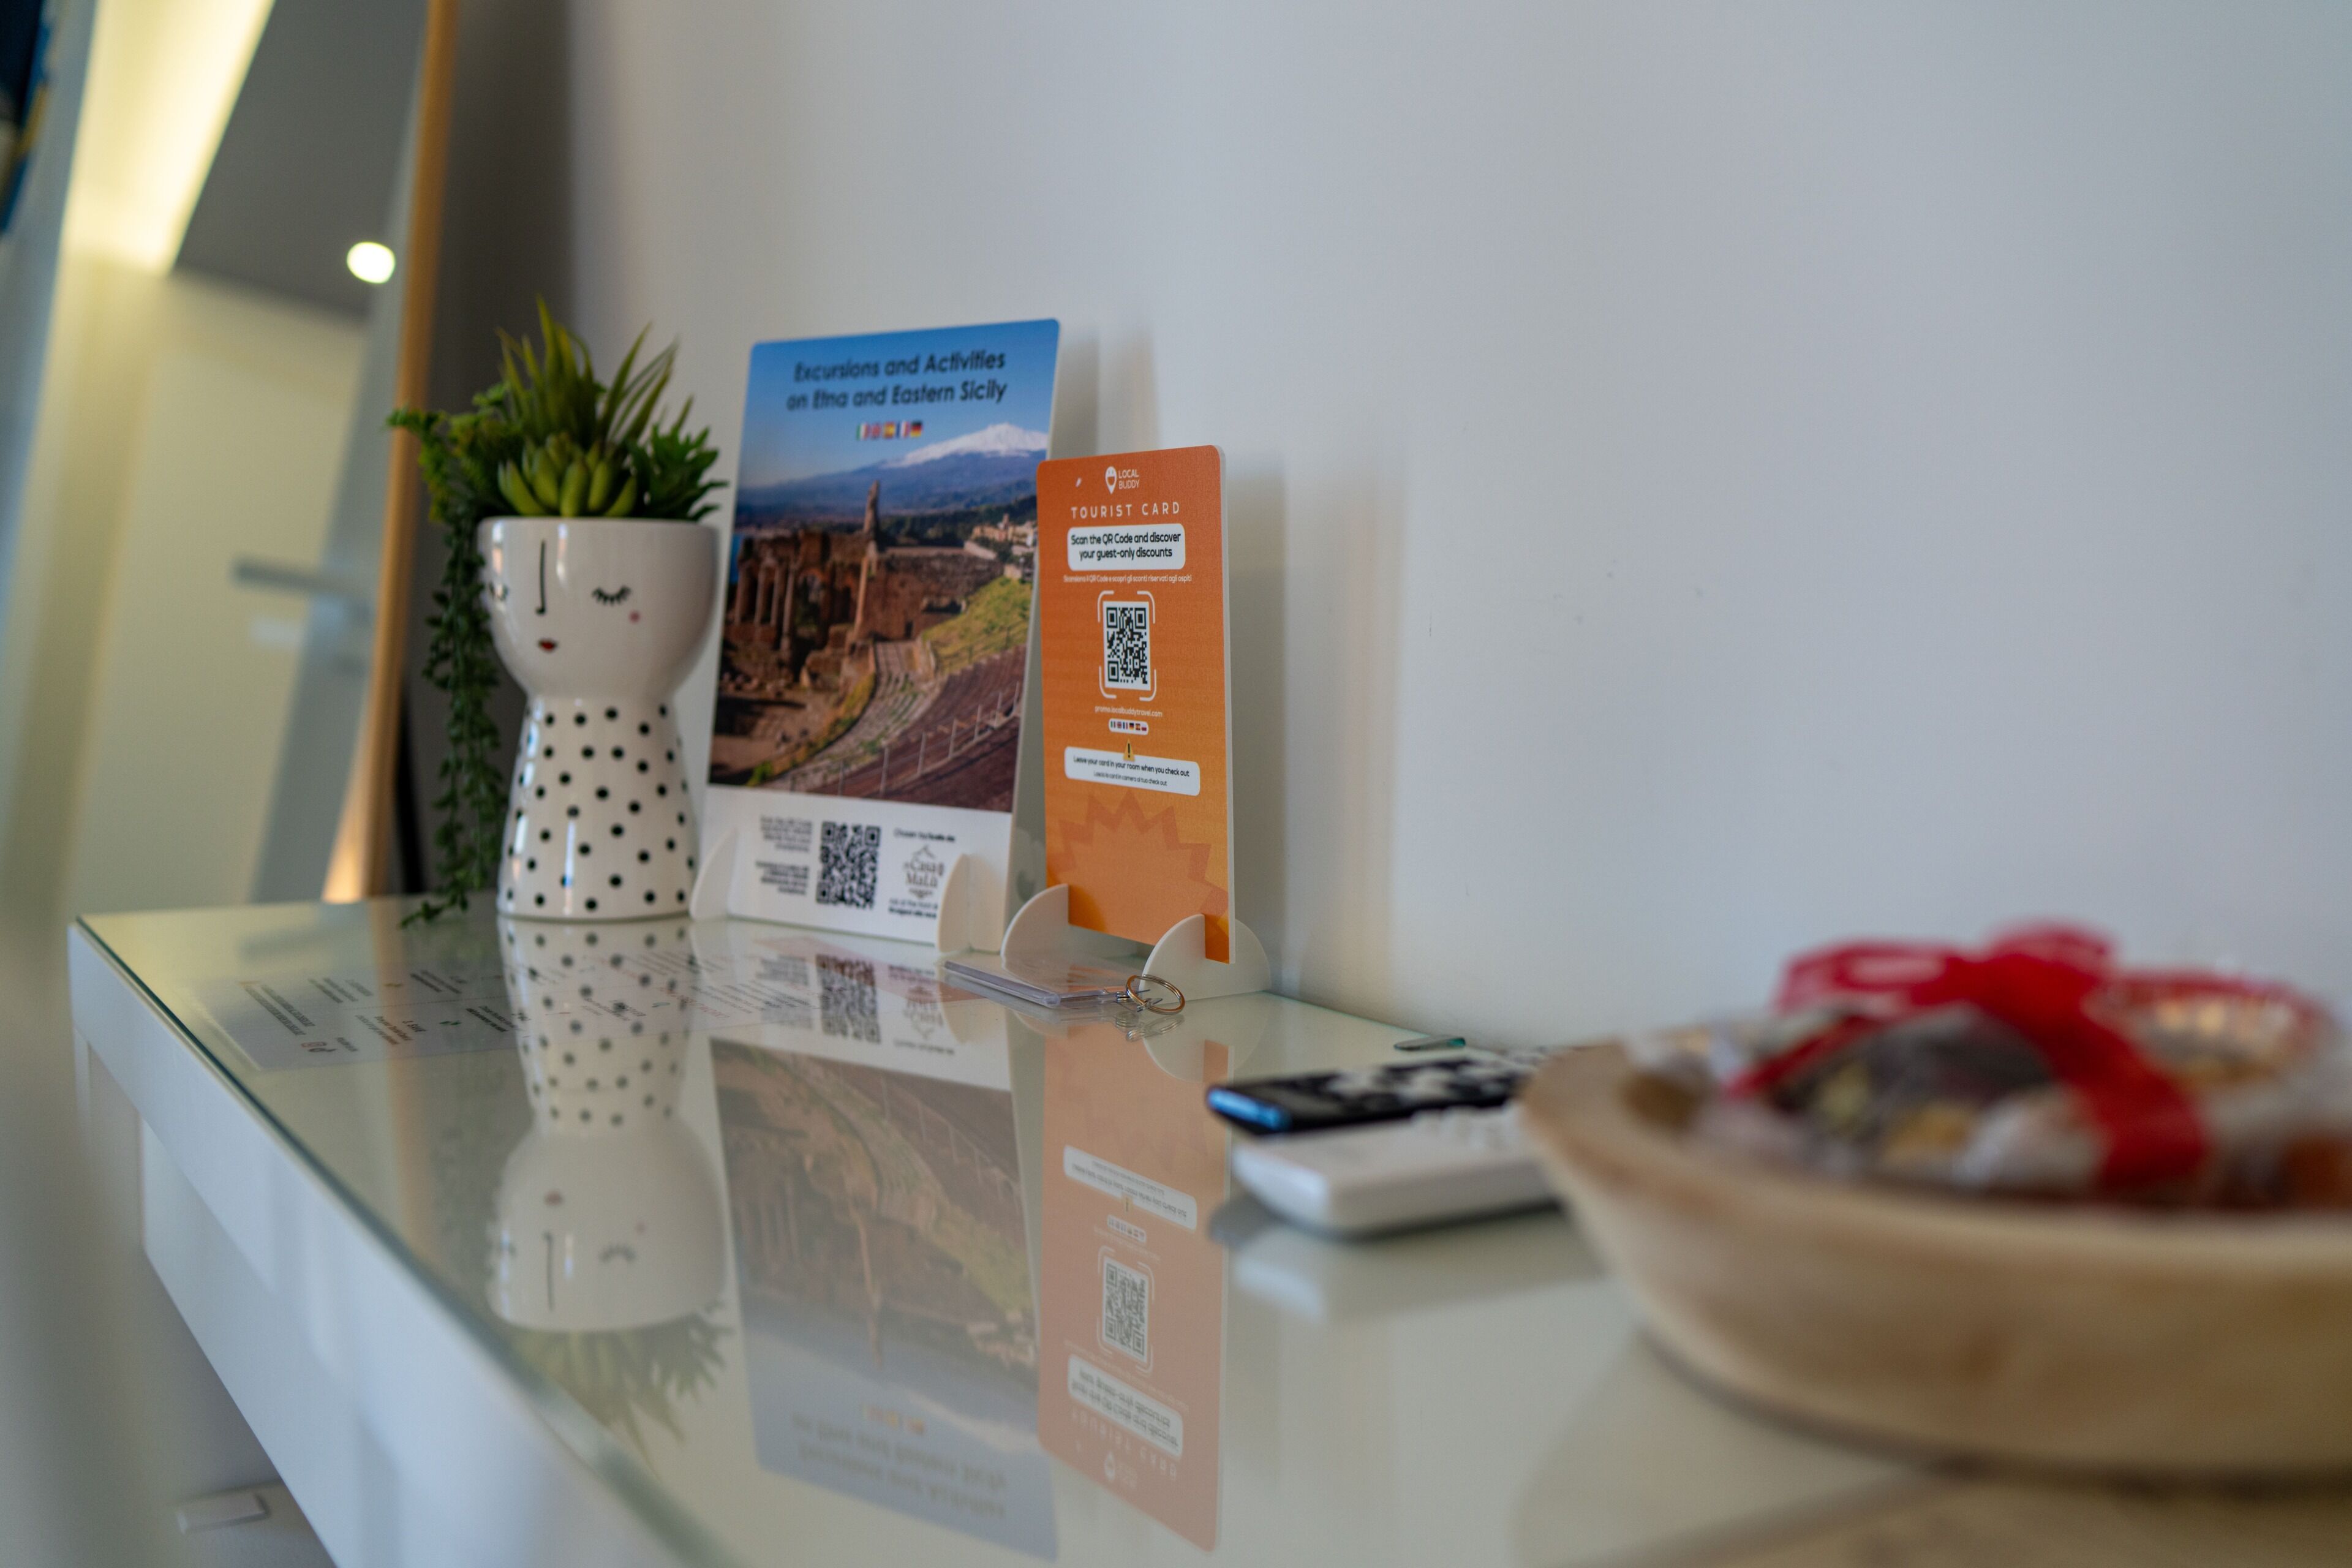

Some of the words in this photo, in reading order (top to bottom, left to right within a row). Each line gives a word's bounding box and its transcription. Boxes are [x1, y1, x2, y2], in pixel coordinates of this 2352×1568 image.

[794, 358, 879, 382] Excursions
[885, 356, 919, 377] and
[925, 350, 1006, 373] Activities
[787, 395, 807, 411] on
[813, 389, 848, 409] Etna
[854, 386, 886, 406] and
[892, 382, 954, 404] Eastern
[960, 379, 1008, 403] Sicily
[1118, 469, 1139, 478] LOCAL
[1118, 480, 1140, 489] BUDDY
[1071, 504, 1133, 519] TOURIST
[1142, 502, 1180, 516] CARD
[1071, 534, 1088, 545] Scan
[1090, 534, 1101, 544] the
[1102, 533, 1113, 546] QR
[1114, 533, 1133, 544] Code
[1134, 532, 1148, 543] and
[1150, 531, 1181, 543] discover
[1079, 550, 1095, 561] your
[1096, 548, 1134, 560] guest-only
[1136, 546, 1172, 557] discounts
[1169, 575, 1177, 584] agli
[1178, 575, 1192, 583] ospiti
[1165, 767, 1180, 776] check
